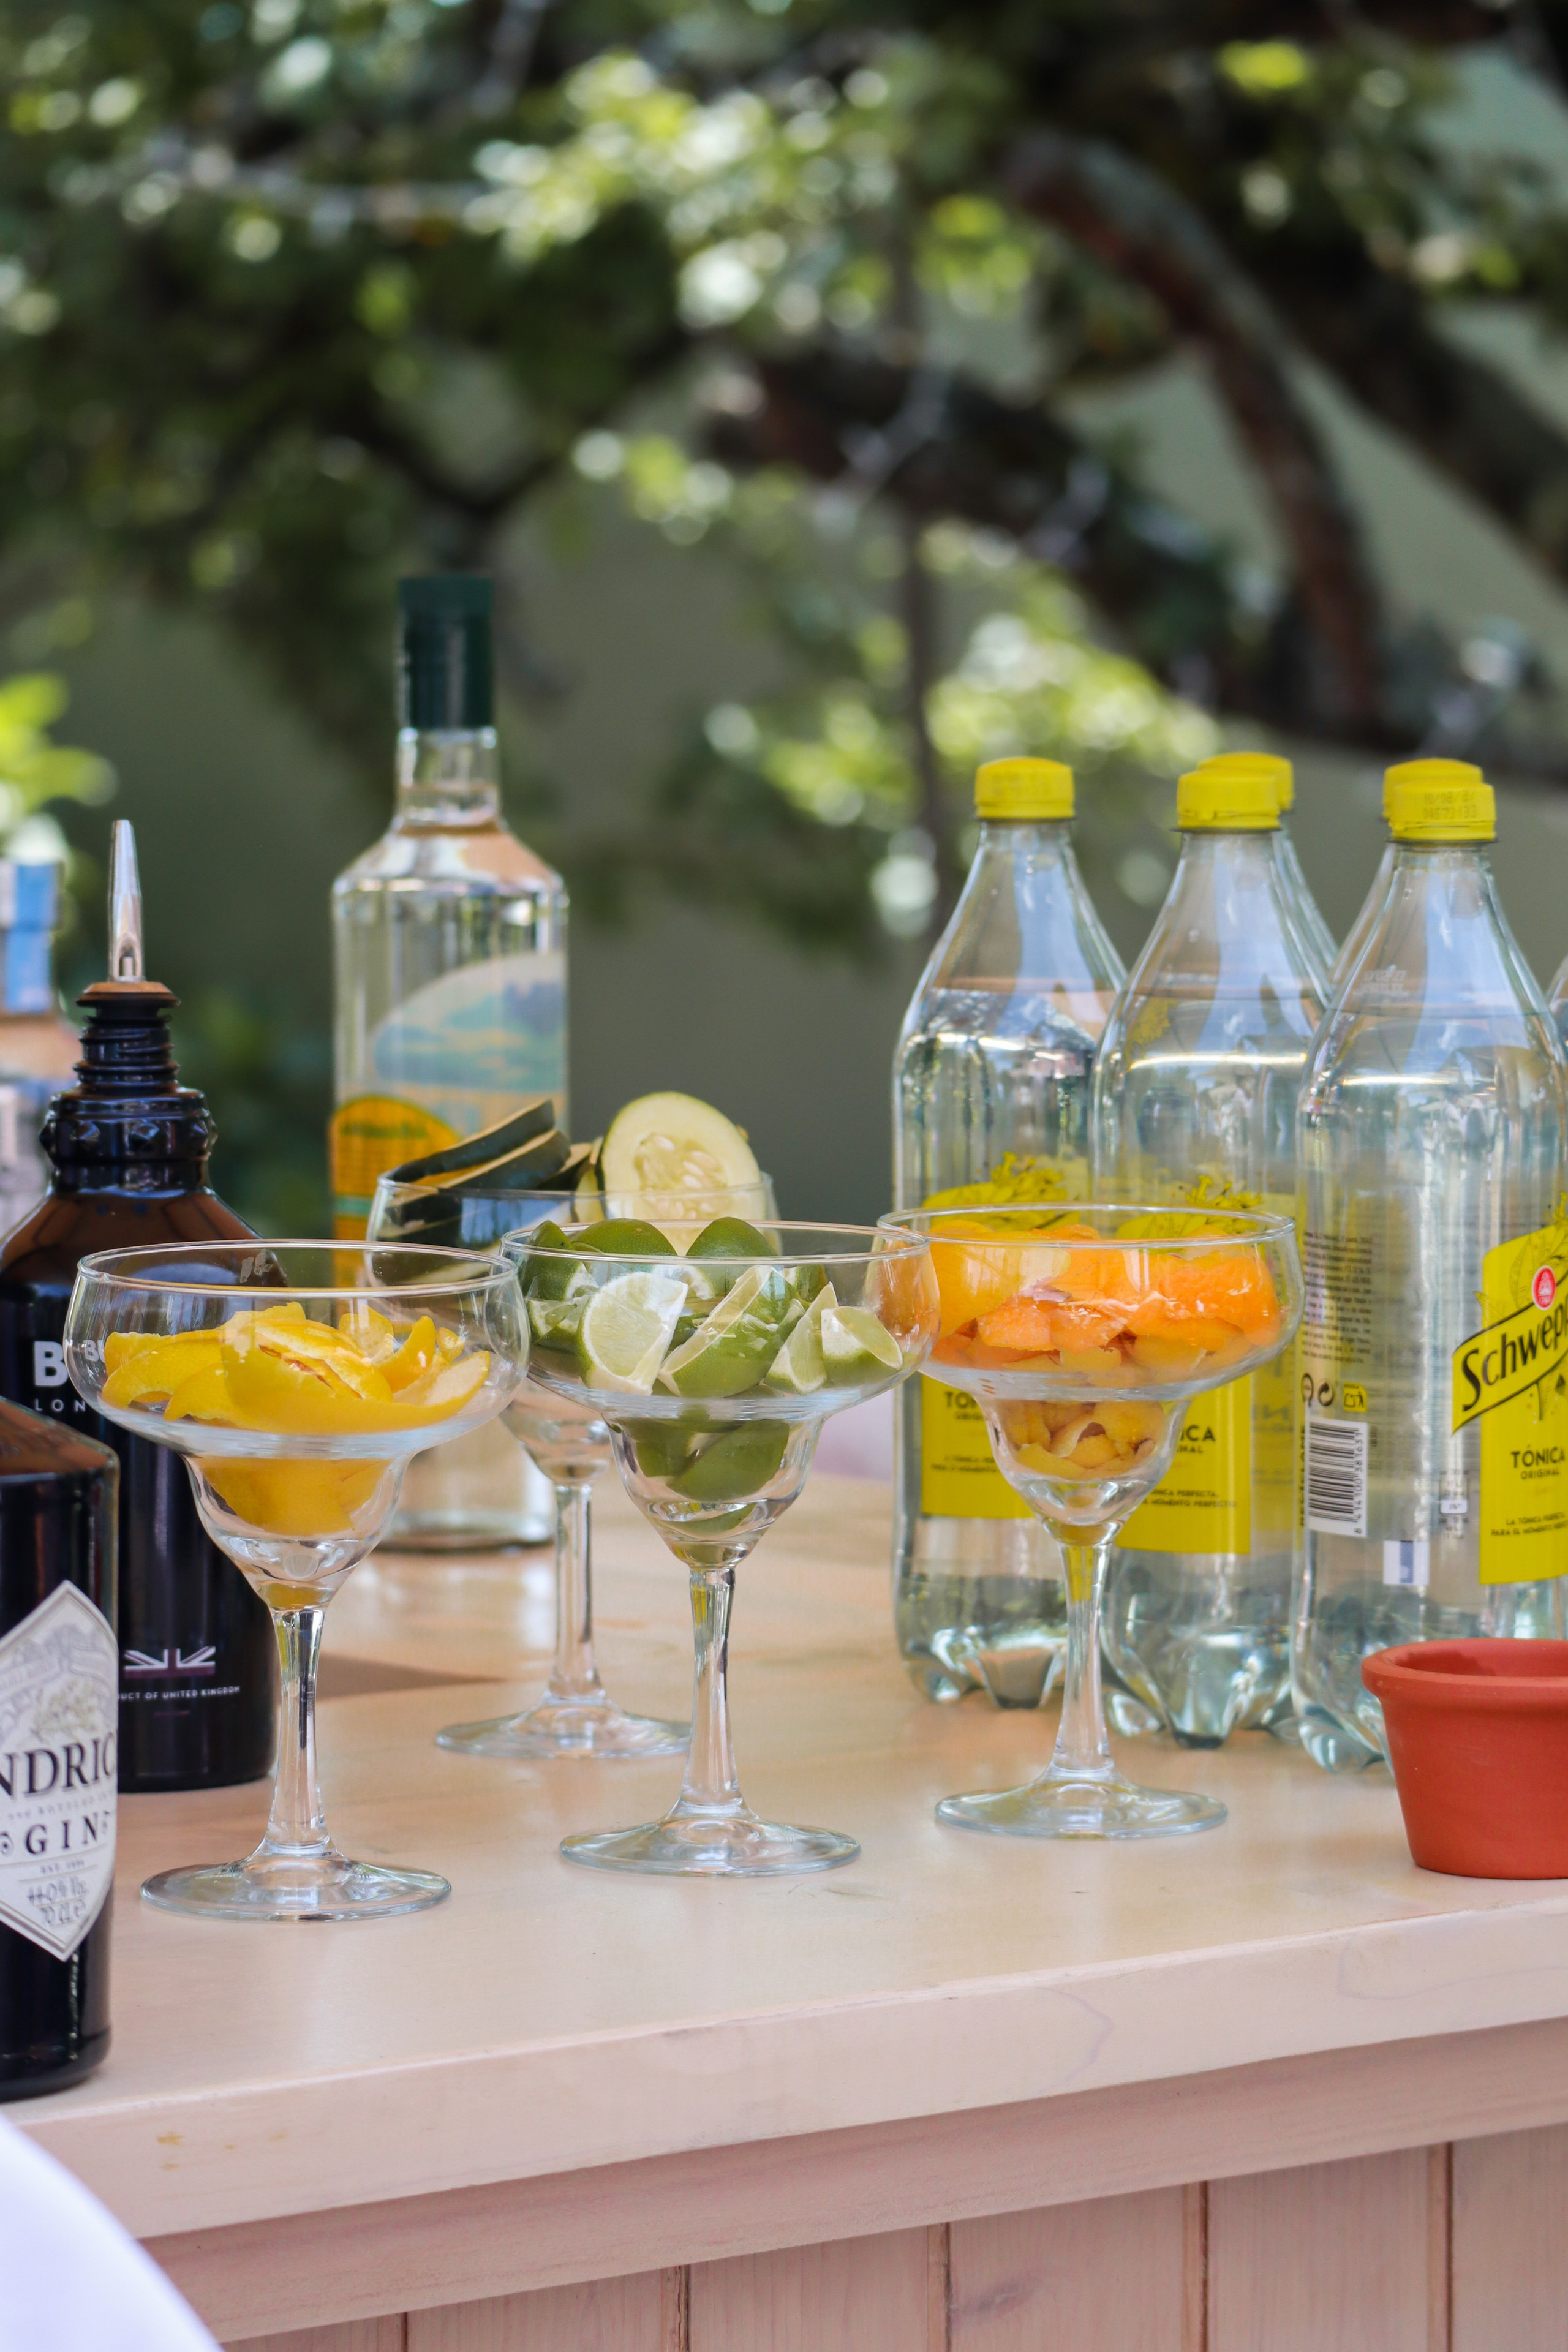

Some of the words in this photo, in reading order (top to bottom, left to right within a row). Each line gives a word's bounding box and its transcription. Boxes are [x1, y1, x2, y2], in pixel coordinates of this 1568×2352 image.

[33, 1398, 86, 1413] LON
[1510, 1444, 1565, 1468] TÓNICA
[1520, 1468, 1560, 1480] ORIGINAL
[145, 1691, 159, 1700] OF
[162, 1689, 198, 1699] UNITED
[200, 1686, 240, 1696] KINGDOM
[24, 1812, 99, 1855] GIN
